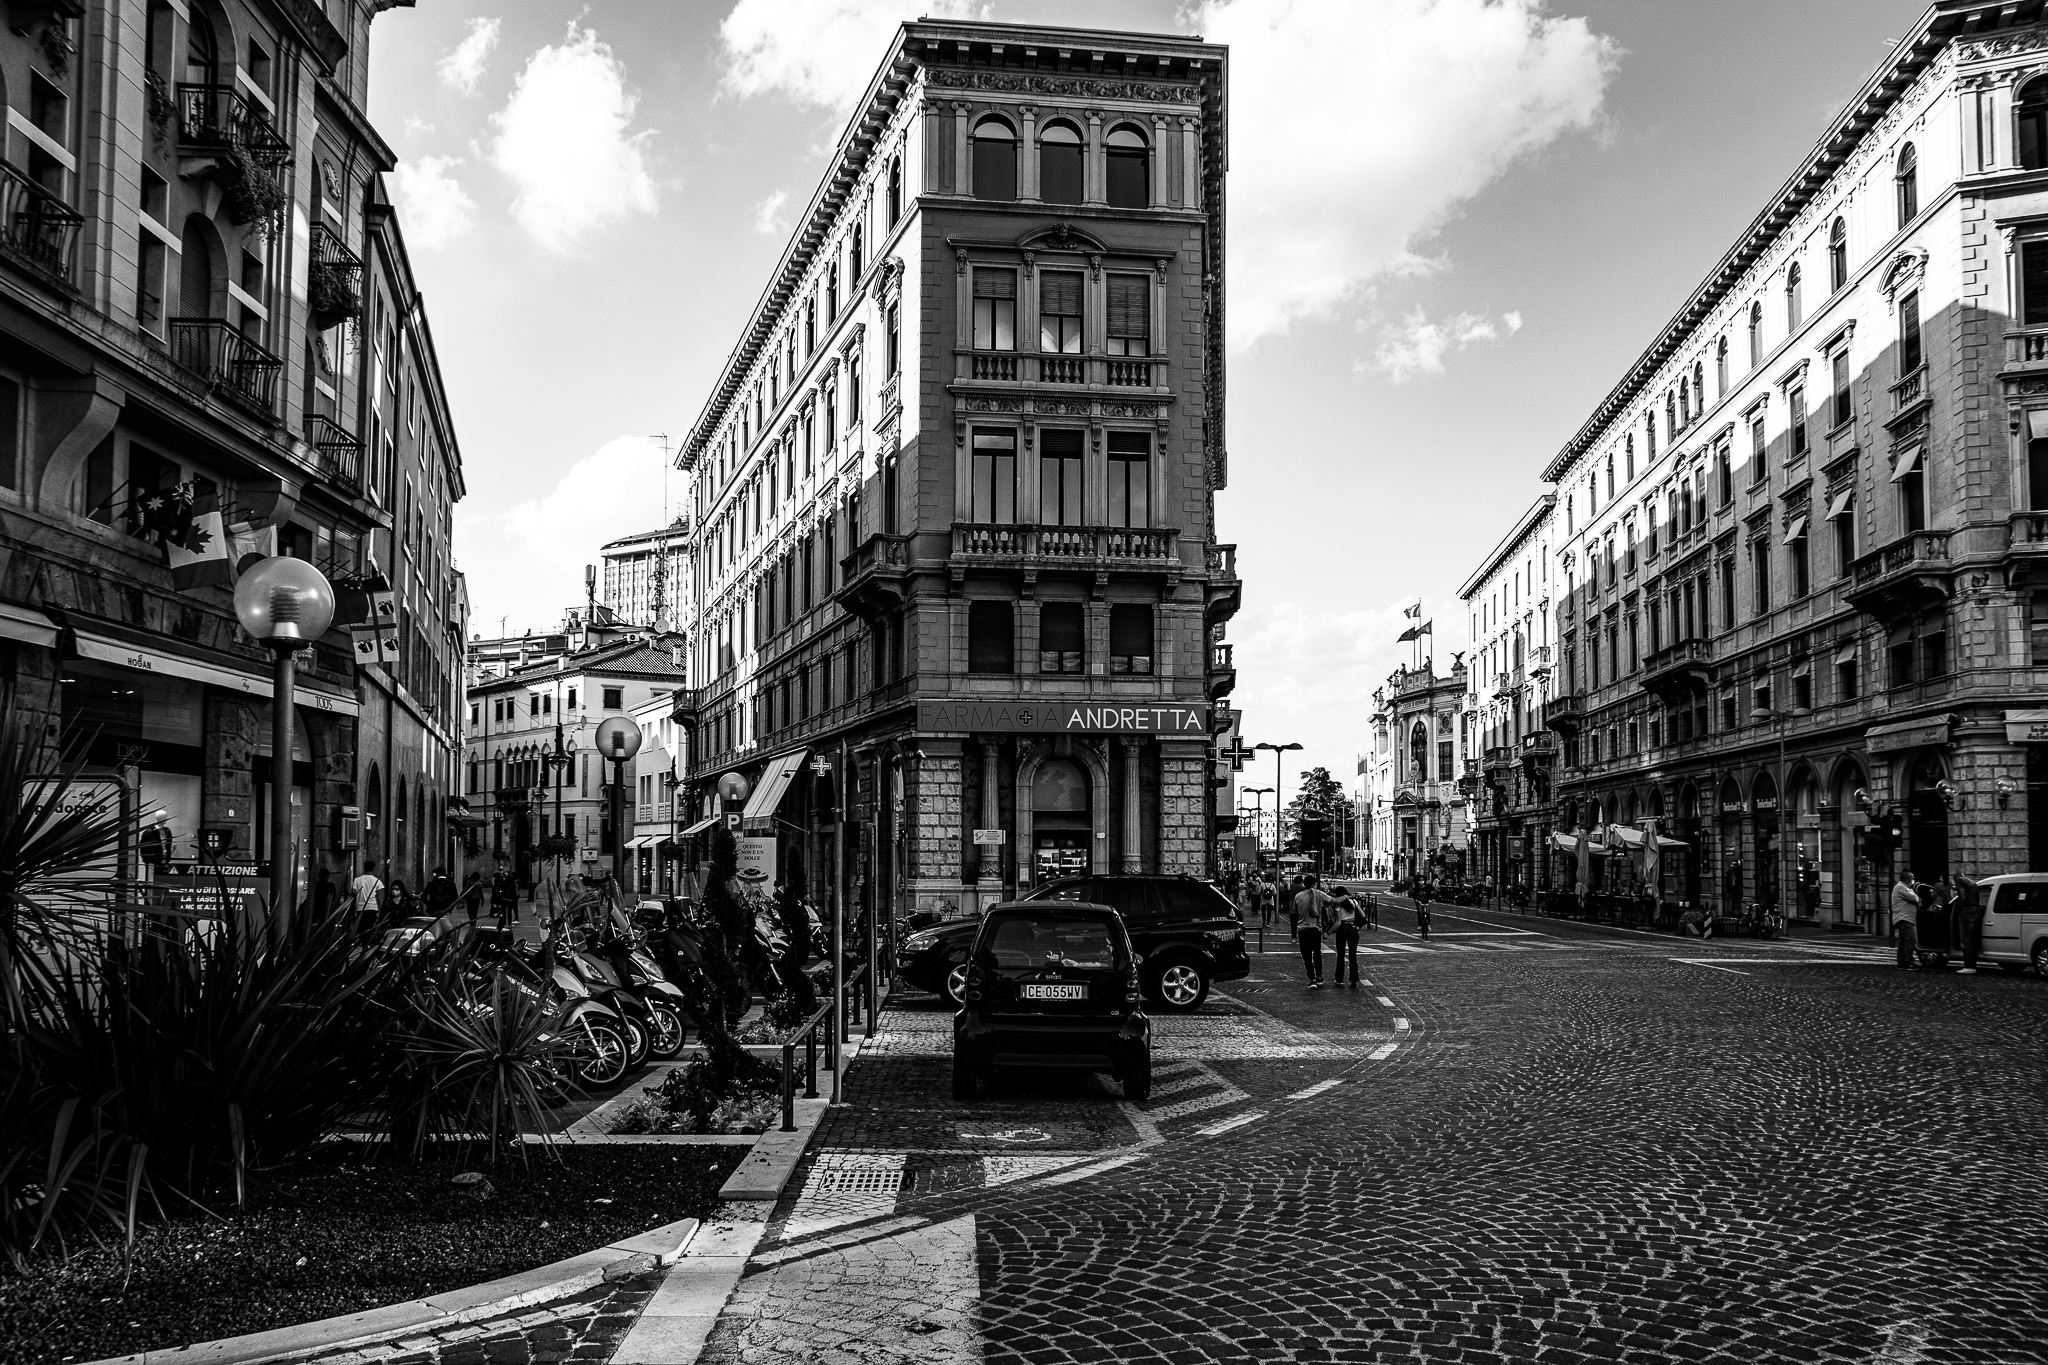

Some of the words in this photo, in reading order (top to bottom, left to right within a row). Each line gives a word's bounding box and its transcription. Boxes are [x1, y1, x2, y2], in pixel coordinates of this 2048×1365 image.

[127, 657, 152, 670] HOGAN
[920, 706, 1062, 728] FARMACIA
[1066, 708, 1203, 730] ANDRETTA
[728, 814, 740, 830] P
[1028, 986, 1042, 998] CE
[1045, 986, 1081, 998] 055WV
